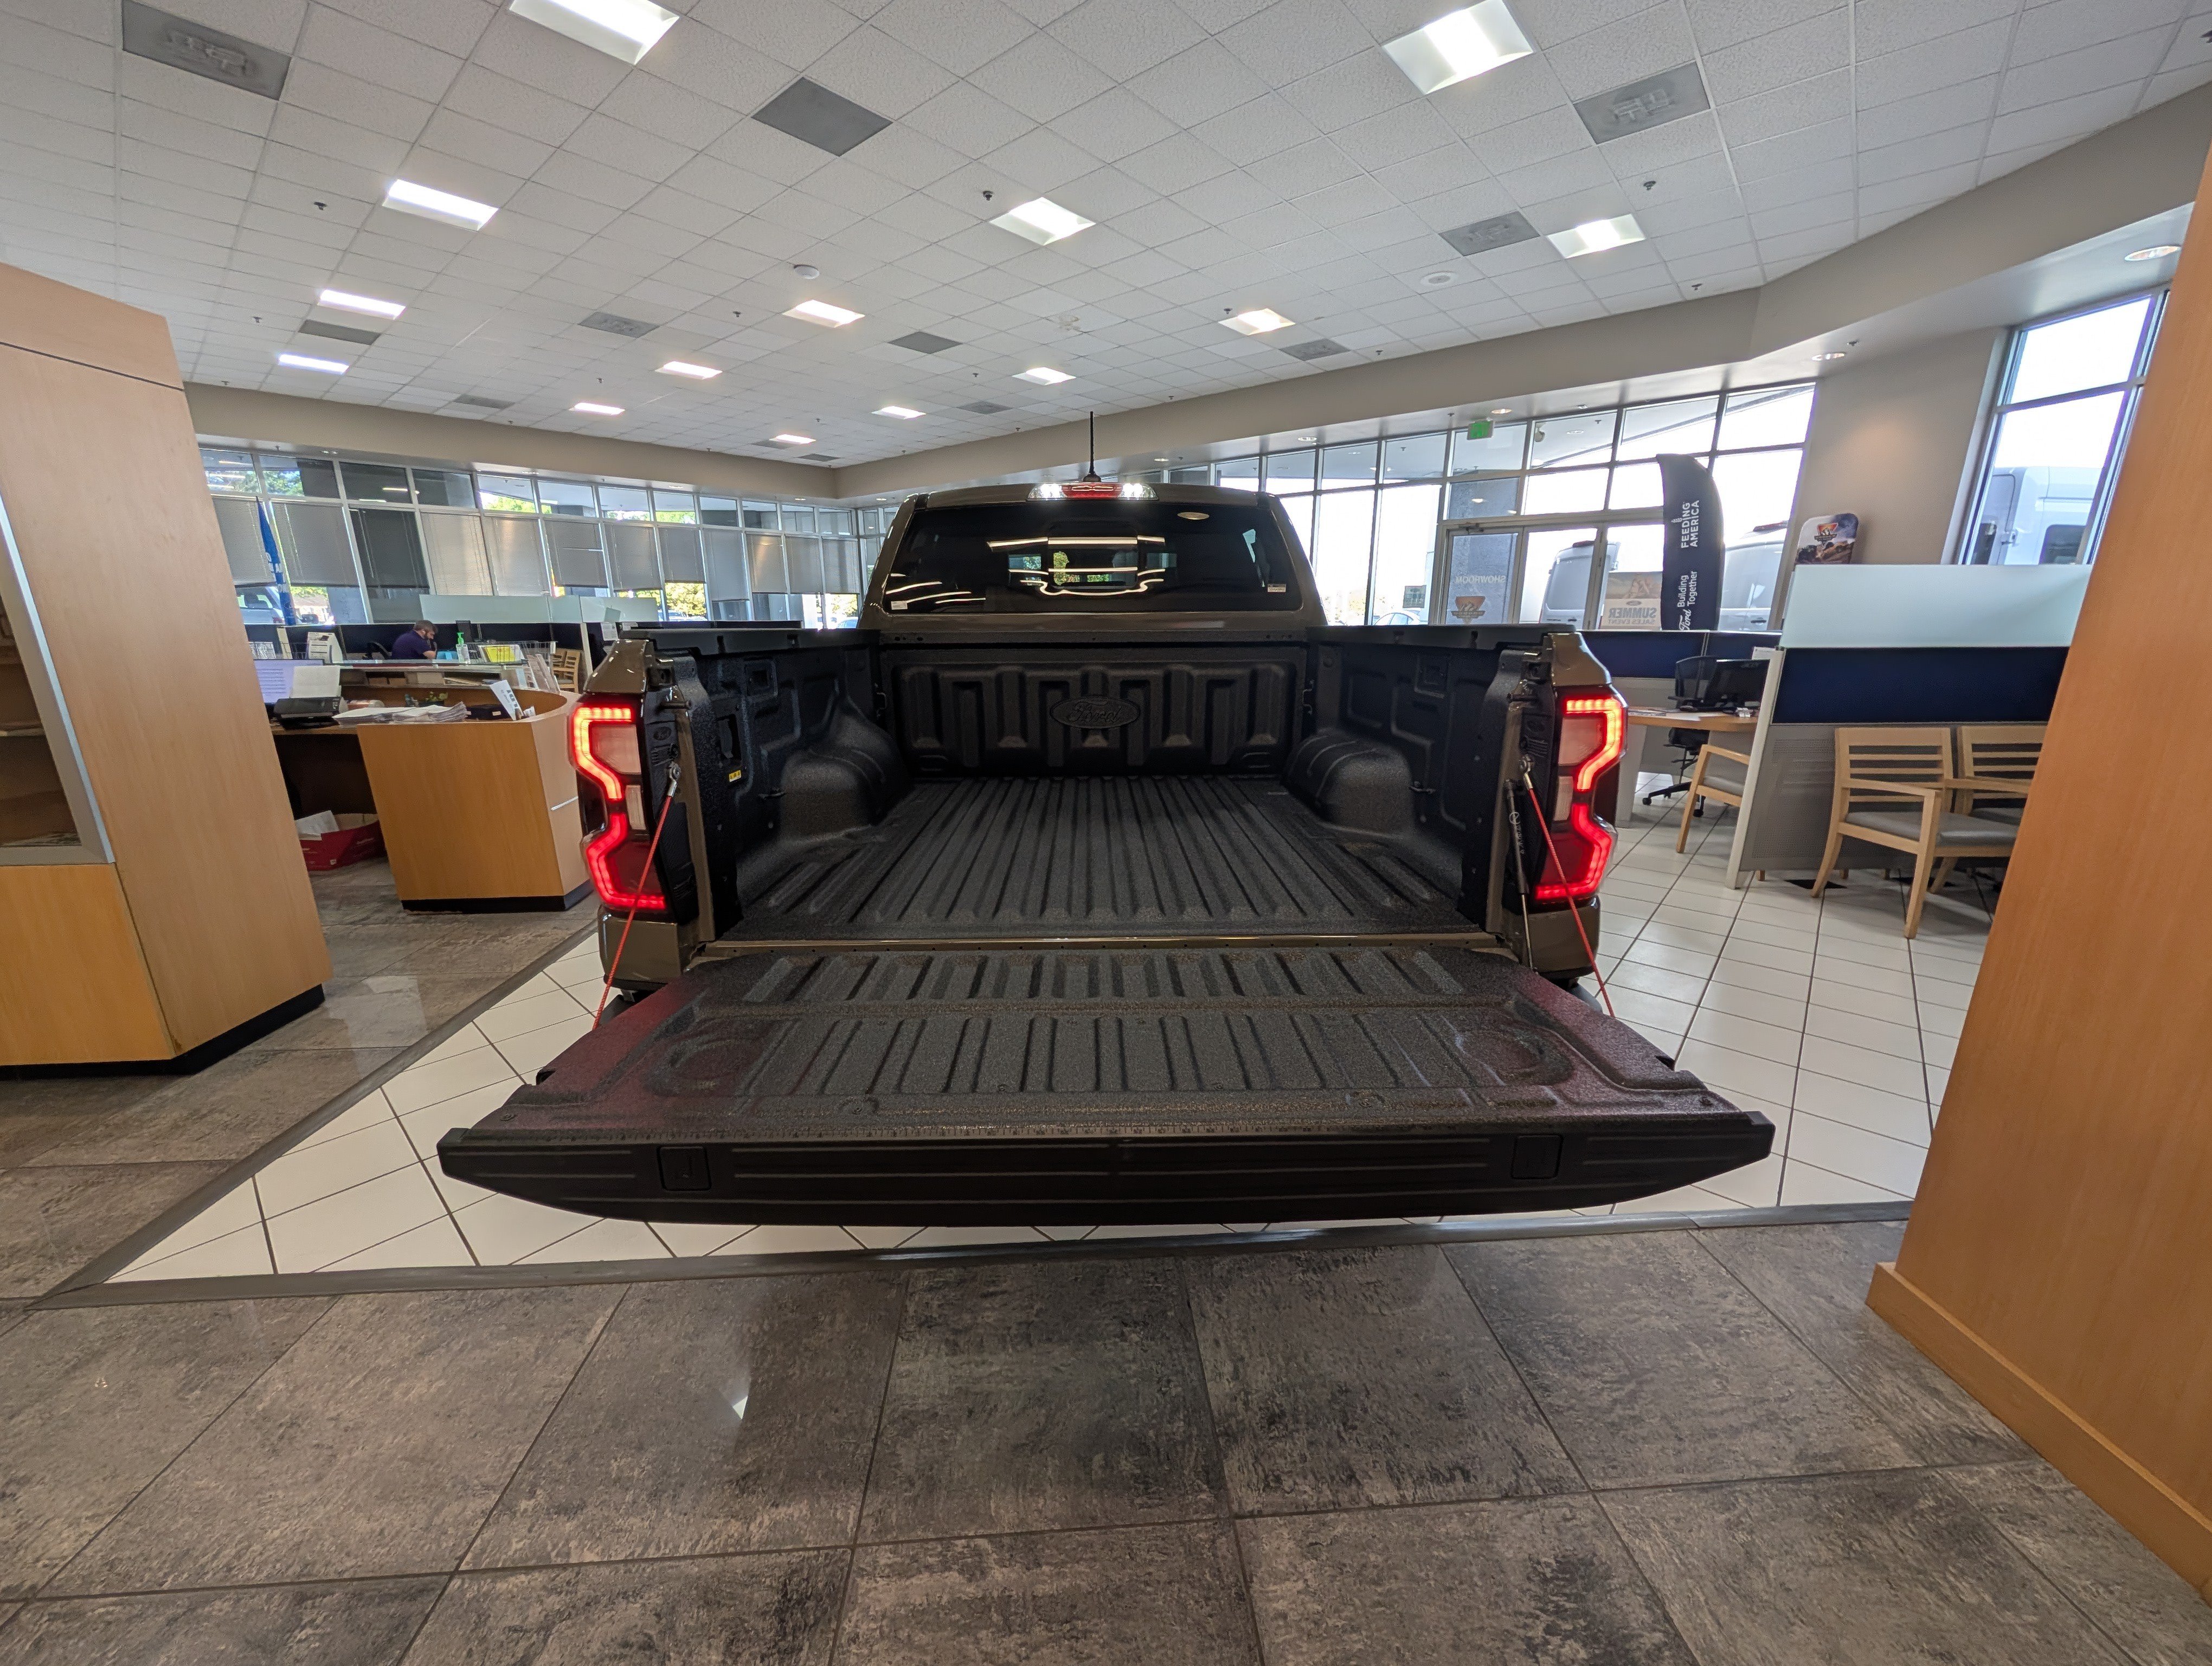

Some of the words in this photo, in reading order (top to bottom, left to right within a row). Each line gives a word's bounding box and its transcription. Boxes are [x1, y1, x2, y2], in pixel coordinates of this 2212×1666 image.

[1681, 502, 1690, 548] FEEDING
[1690, 500, 1700, 547] AMERICA
[1677, 575, 1689, 607] Building
[1687, 571, 1697, 606] Together
[1679, 609, 1692, 631] Ford
[1066, 701, 1122, 723] Ford
